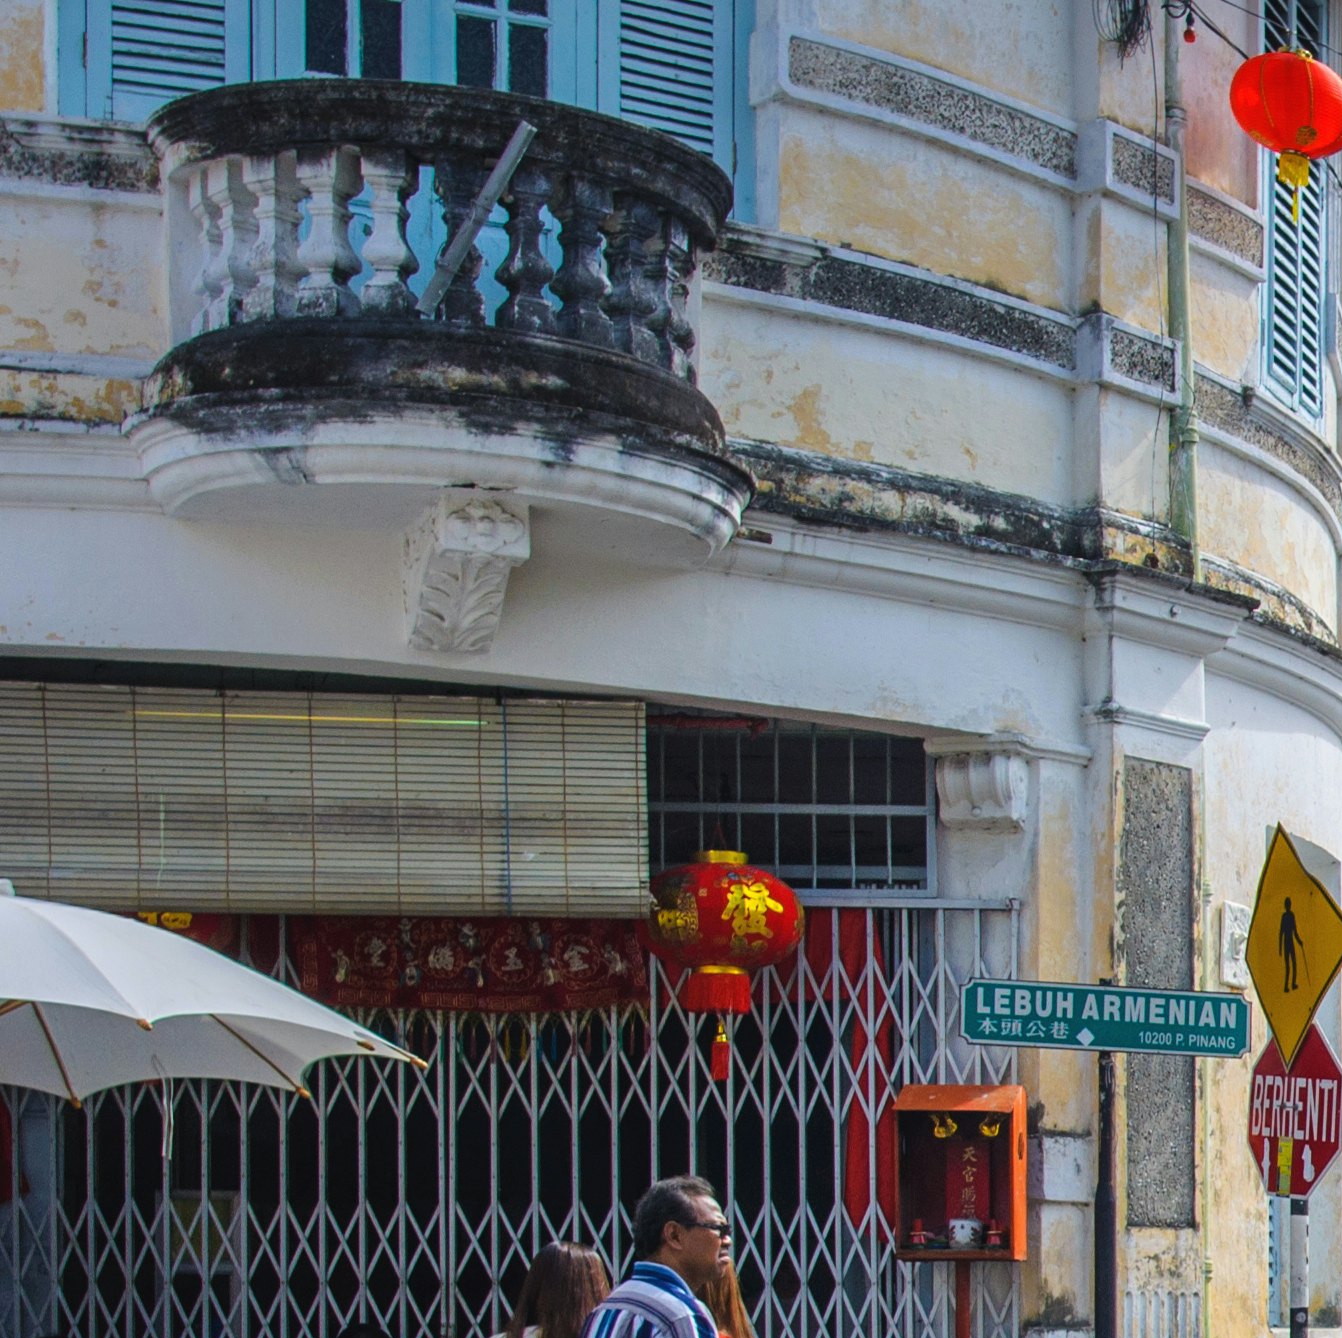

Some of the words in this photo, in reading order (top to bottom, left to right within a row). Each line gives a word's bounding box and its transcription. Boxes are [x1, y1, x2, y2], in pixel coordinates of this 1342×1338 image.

[976, 986, 1074, 1019] LEBUH
[1081, 993, 1238, 1029] ARMENIAN
[976, 1016, 1070, 1040] 本頭公巷
[1138, 1030, 1173, 1046] 10200
[1175, 1033, 1186, 1046] P.
[1188, 1034, 1236, 1050] PINANG
[1251, 1074, 1338, 1143] BERHENTI
